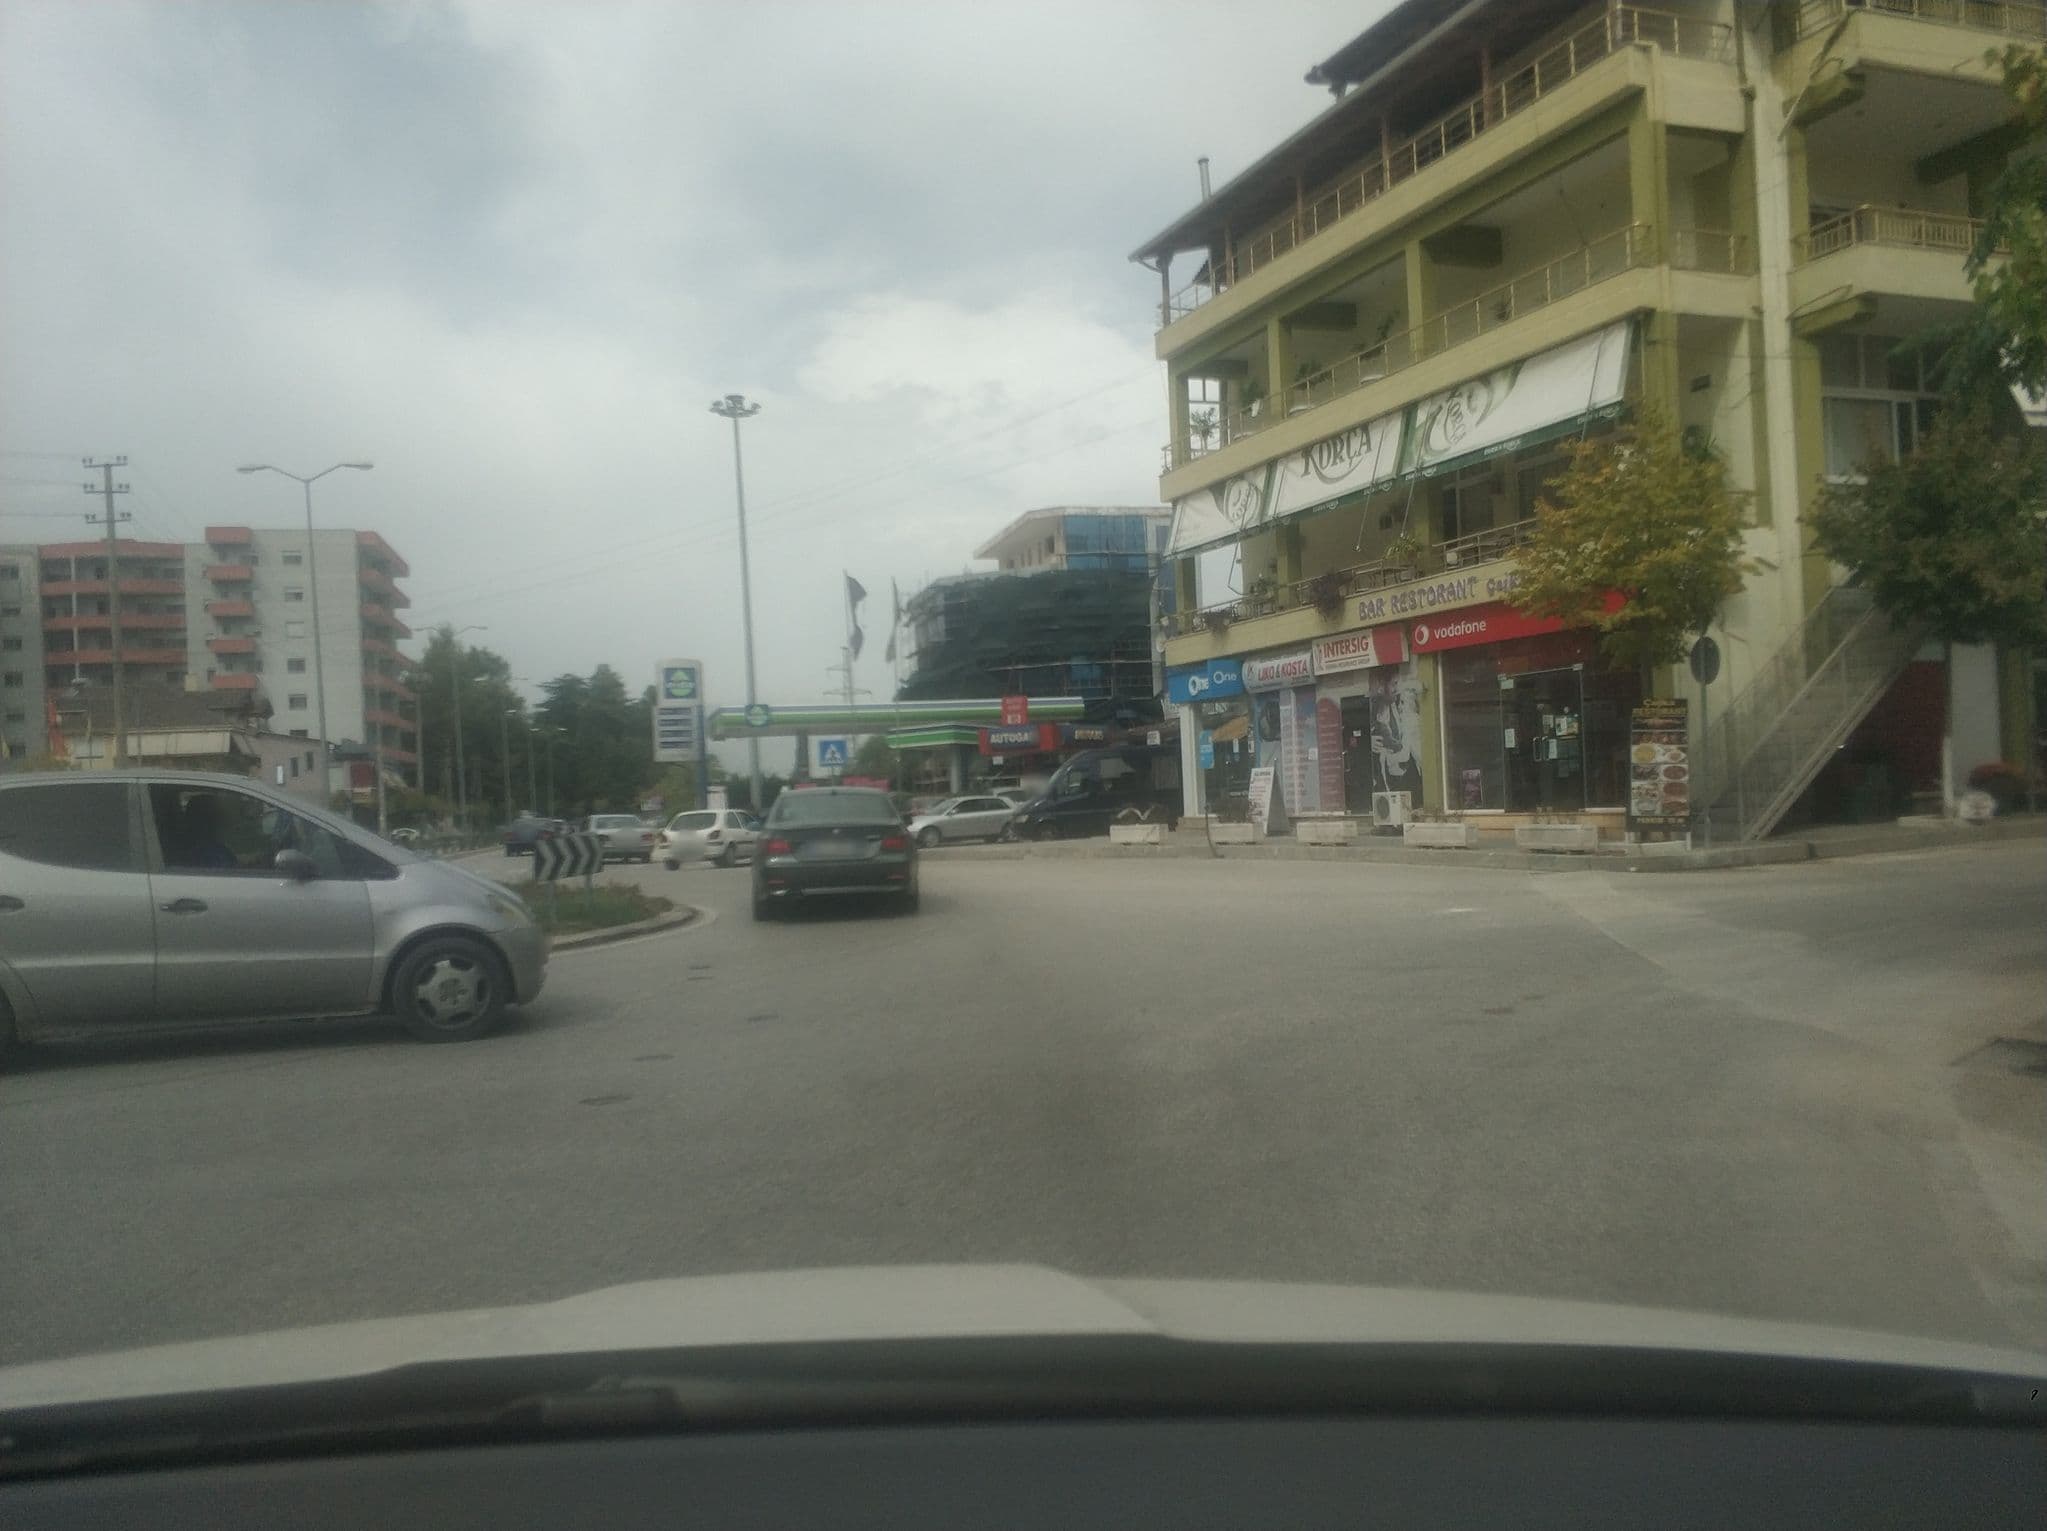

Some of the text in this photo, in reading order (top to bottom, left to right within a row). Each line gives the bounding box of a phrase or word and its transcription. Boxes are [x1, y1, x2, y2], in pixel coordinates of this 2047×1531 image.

[1359, 600, 1386, 621] BAR
[1390, 576, 1477, 615] RESTORANT
[1433, 619, 1487, 640] vodafone
[1322, 636, 1370, 658] INTERSIG
[1213, 670, 1238, 685] One
[1281, 659, 1309, 679] KOSTA
